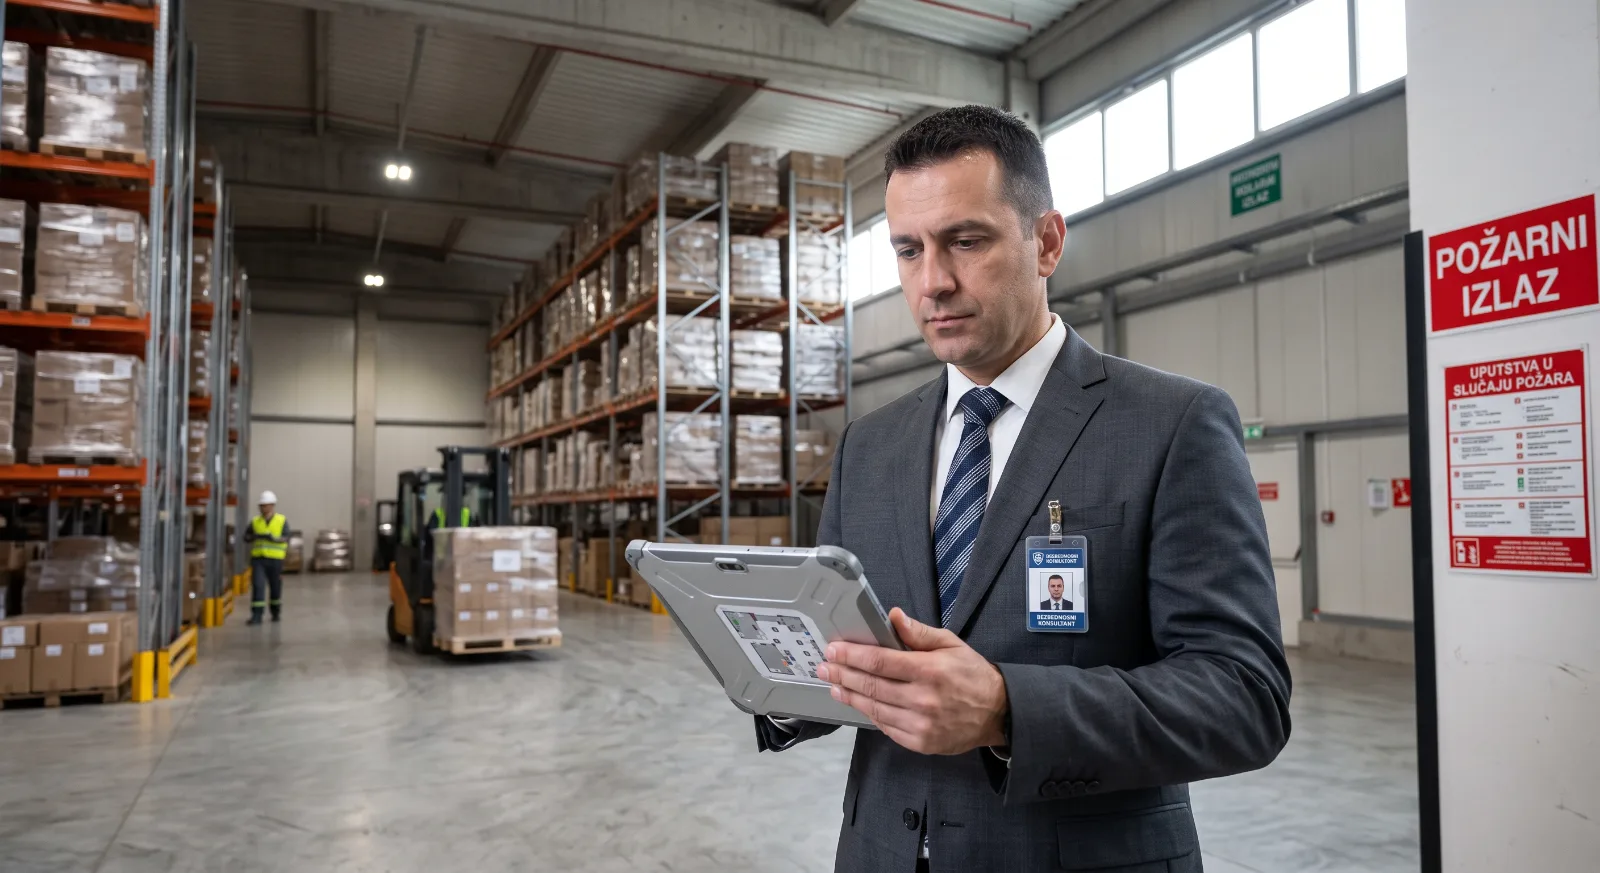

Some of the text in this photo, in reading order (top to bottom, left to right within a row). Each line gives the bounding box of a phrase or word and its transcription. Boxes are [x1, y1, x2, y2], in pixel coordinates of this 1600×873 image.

[1436, 214, 1587, 280] POŽARNI
[1462, 267, 1560, 317] IZLAZ
[1453, 371, 1575, 397] SLUČAJU POŽARA
[1470, 357, 1553, 379] UPUTSTVA U
